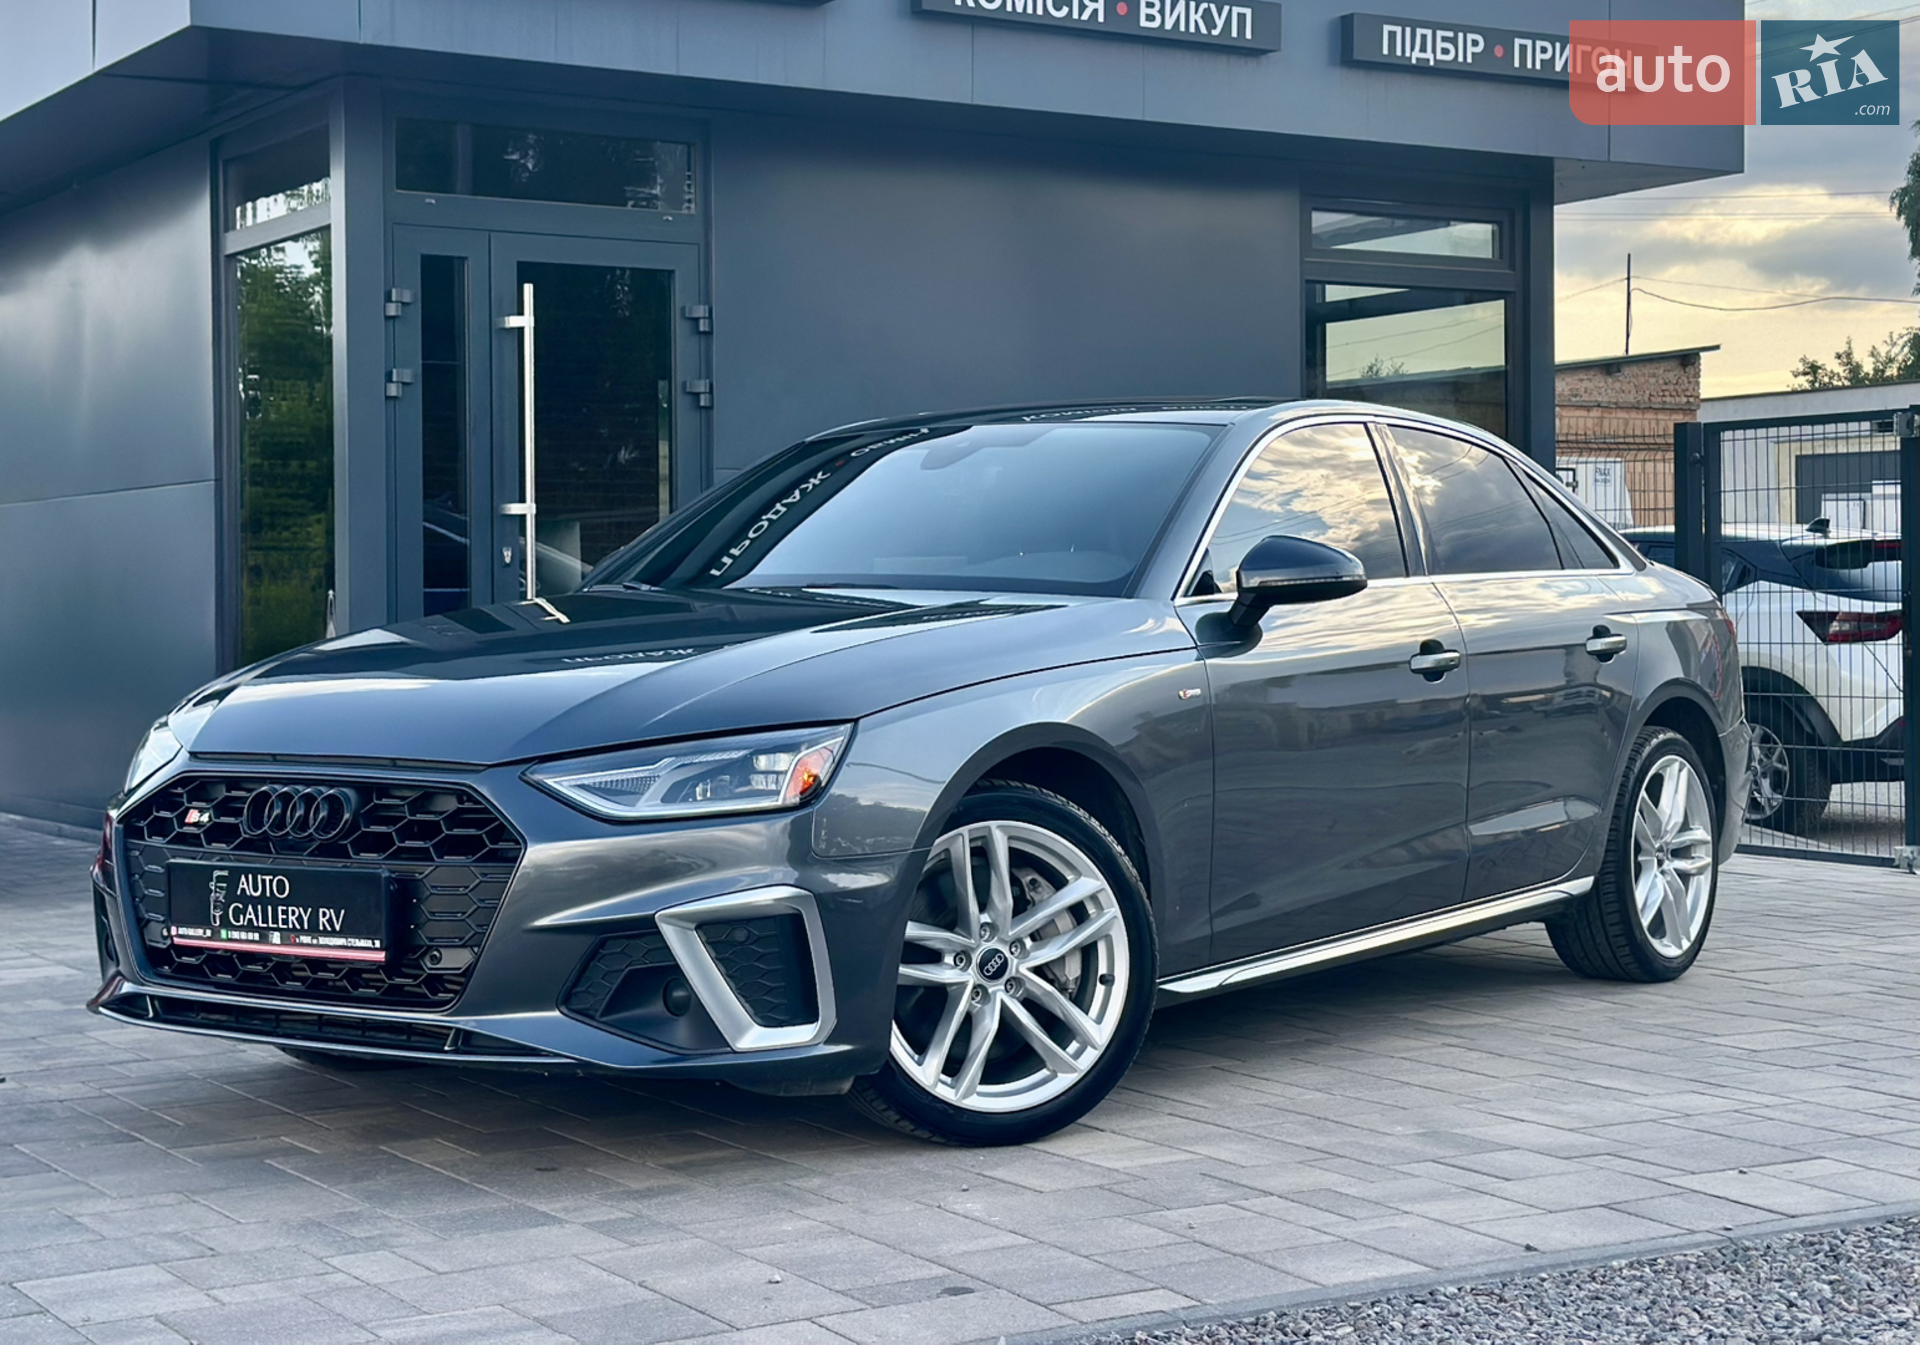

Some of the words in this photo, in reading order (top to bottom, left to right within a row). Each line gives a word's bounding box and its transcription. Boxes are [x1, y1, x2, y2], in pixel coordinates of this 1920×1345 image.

[1139, 0, 1252, 39] ВИКУП
[1382, 24, 1485, 66] ПІДБІР
[236, 873, 290, 898] AUTO
[228, 902, 312, 930] GALLERY
[319, 908, 345, 931] RV
